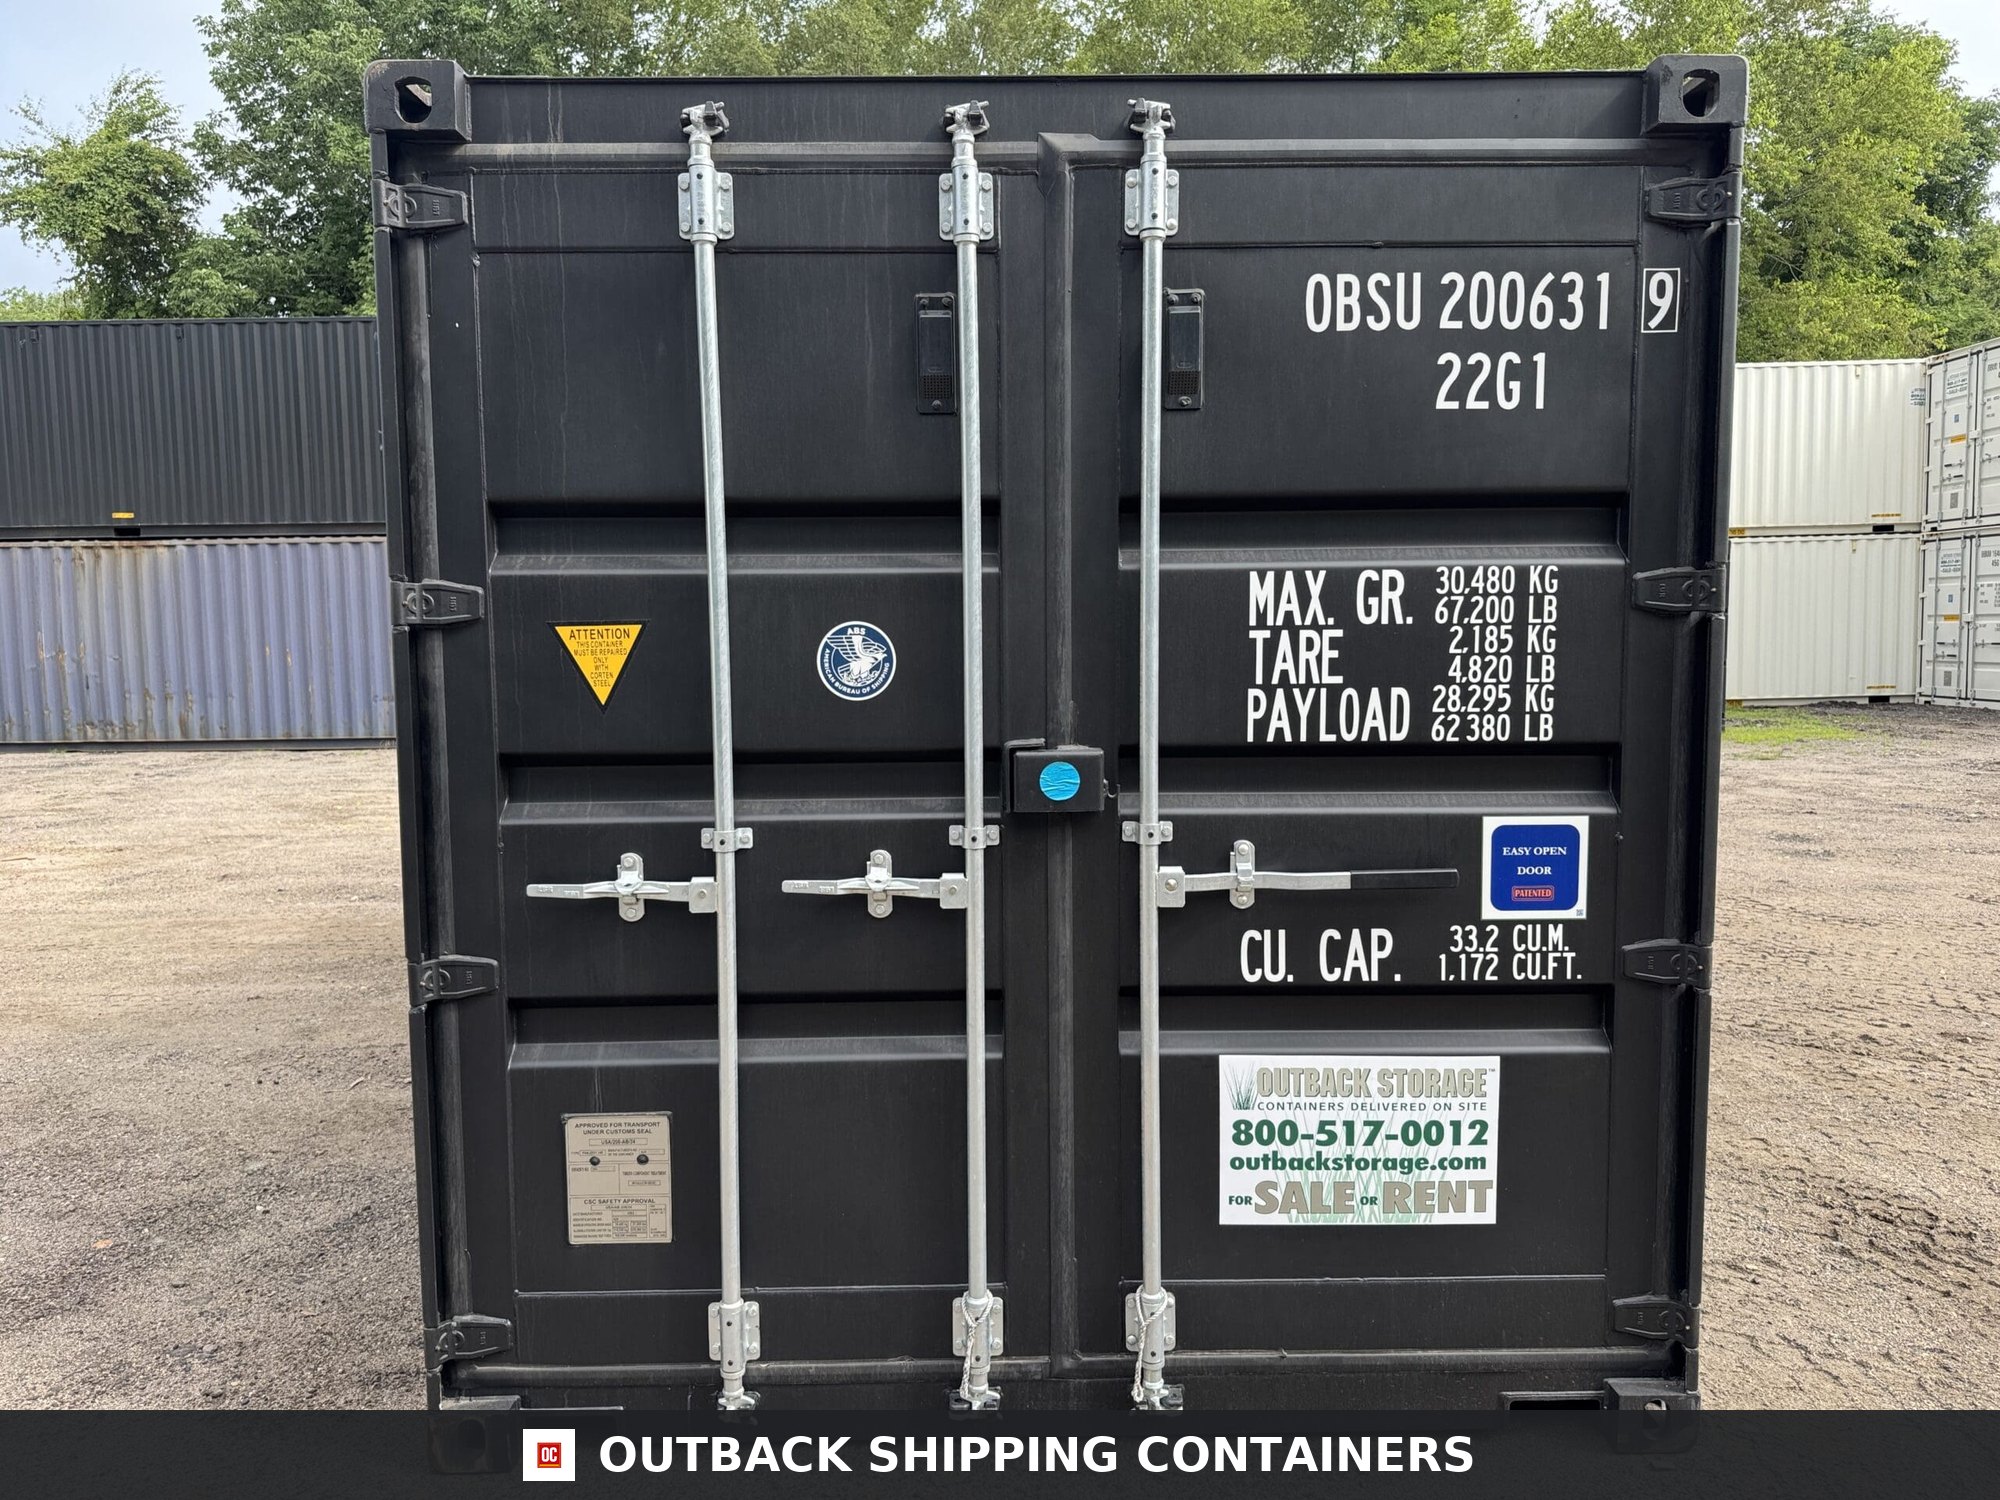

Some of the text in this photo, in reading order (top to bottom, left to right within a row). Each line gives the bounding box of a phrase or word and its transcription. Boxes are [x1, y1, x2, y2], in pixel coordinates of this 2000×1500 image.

[1305, 271, 1674, 333] OBSU 200631 9
[1435, 352, 1546, 410] 22G1
[1249, 565, 1559, 626] MAX. GR. 30,480 KG
[1434, 595, 1558, 624] 67,200 LB
[569, 628, 630, 640] ATTENTION
[590, 640, 623, 648] CONTAINER
[847, 627, 866, 635] ABS
[599, 648, 627, 656] REPAIRED
[1249, 625, 1557, 685] TARE 2,185 KG
[590, 672, 614, 680] CORTEN
[823, 648, 890, 694] AMERICAN BUREAU OF SHIPPING
[1447, 655, 1556, 684] 4,820 LB
[1247, 684, 1555, 742] PAYLOAD 28,295 KG
[1524, 714, 1554, 742] LB
[1502, 846, 1567, 856] EASY OPEN
[1517, 866, 1552, 875] DOOR
[1514, 889, 1552, 897] PATENTED
[1240, 924, 1569, 982] CU. CAP. 33.2 CU.M.
[1439, 952, 1582, 981] 1,172 CU.FT.
[1257, 1067, 1372, 1098] OUTBACK
[1377, 1068, 1487, 1098] STORAGE
[1257, 1102, 1487, 1111] CONTAINERS DELIVERED ON SITE
[1232, 1119, 1489, 1146] 800-517-0012
[1229, 1150, 1487, 1175] outbackstorage.com
[1229, 1180, 1493, 1215] FOR SALE OR RENT
